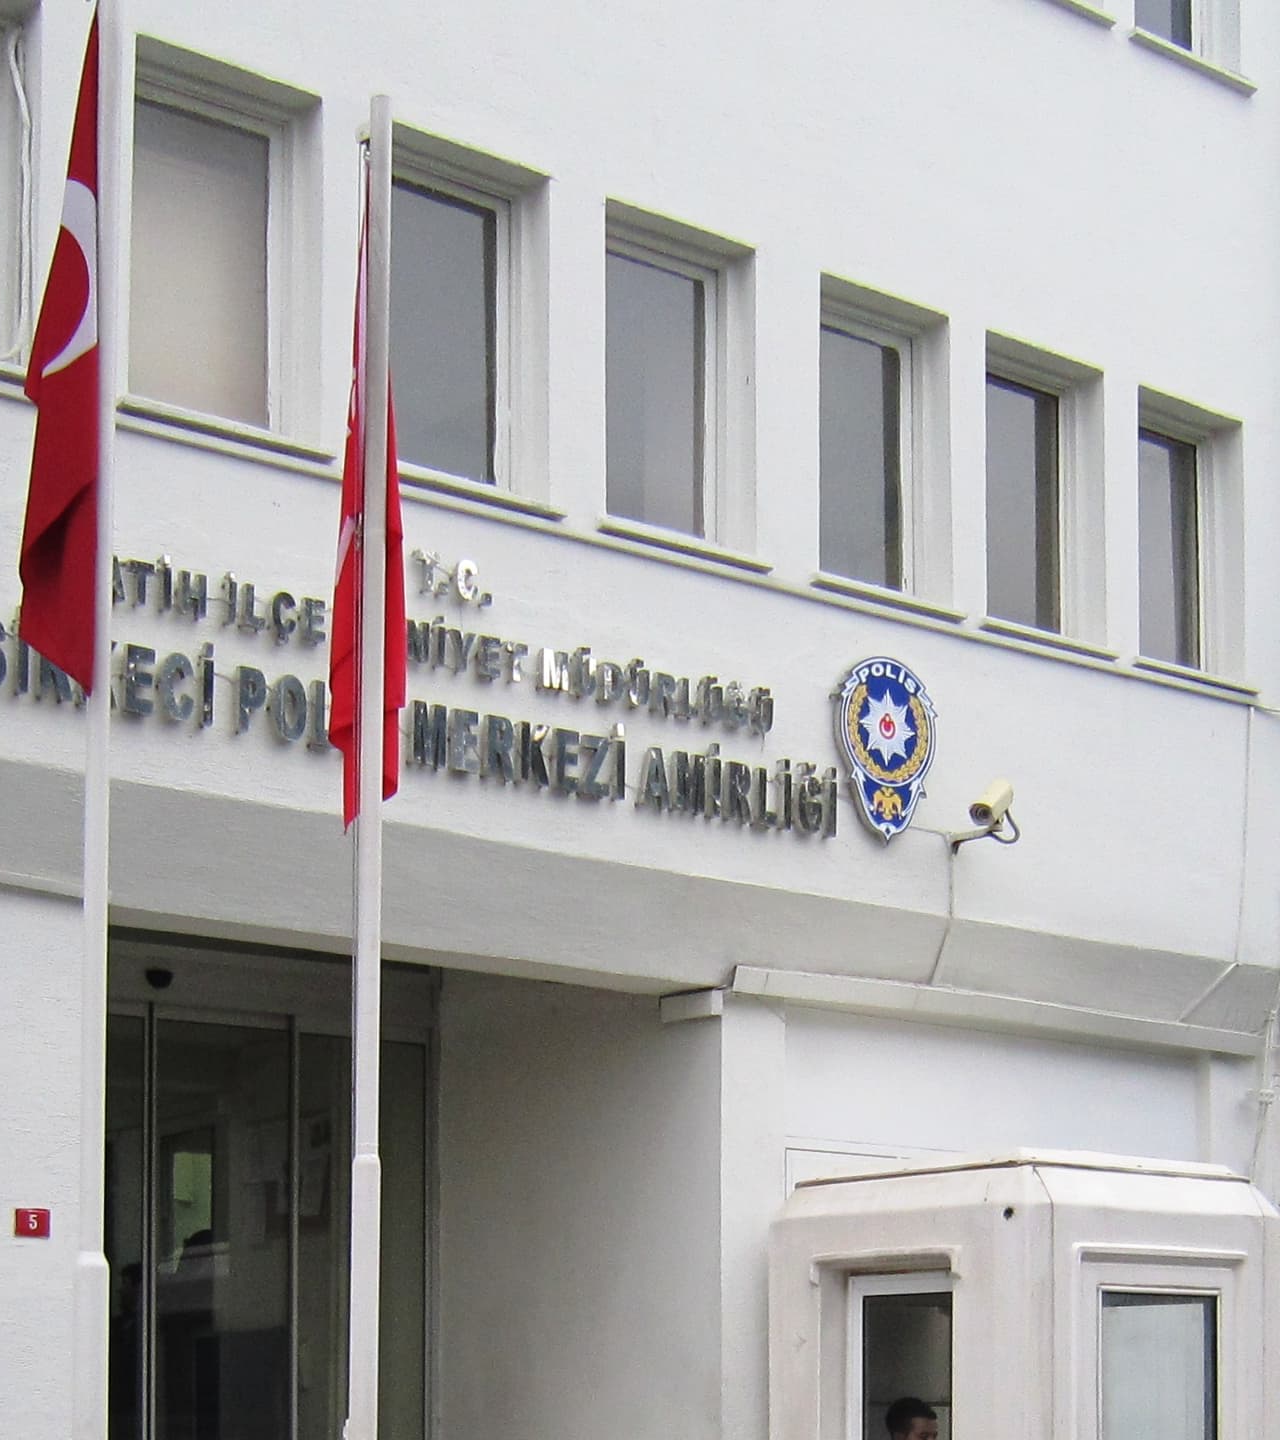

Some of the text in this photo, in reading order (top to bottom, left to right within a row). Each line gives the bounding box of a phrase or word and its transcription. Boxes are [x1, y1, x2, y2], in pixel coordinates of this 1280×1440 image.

[407, 615, 529, 683] NİYET
[536, 646, 775, 737] MÜDÜRLÜĞÜ
[234, 665, 330, 755] POL
[406, 699, 626, 802] MERKEZİ
[634, 743, 838, 839] AMİRLİĞİ
[28, 1214, 38, 1231] 5
